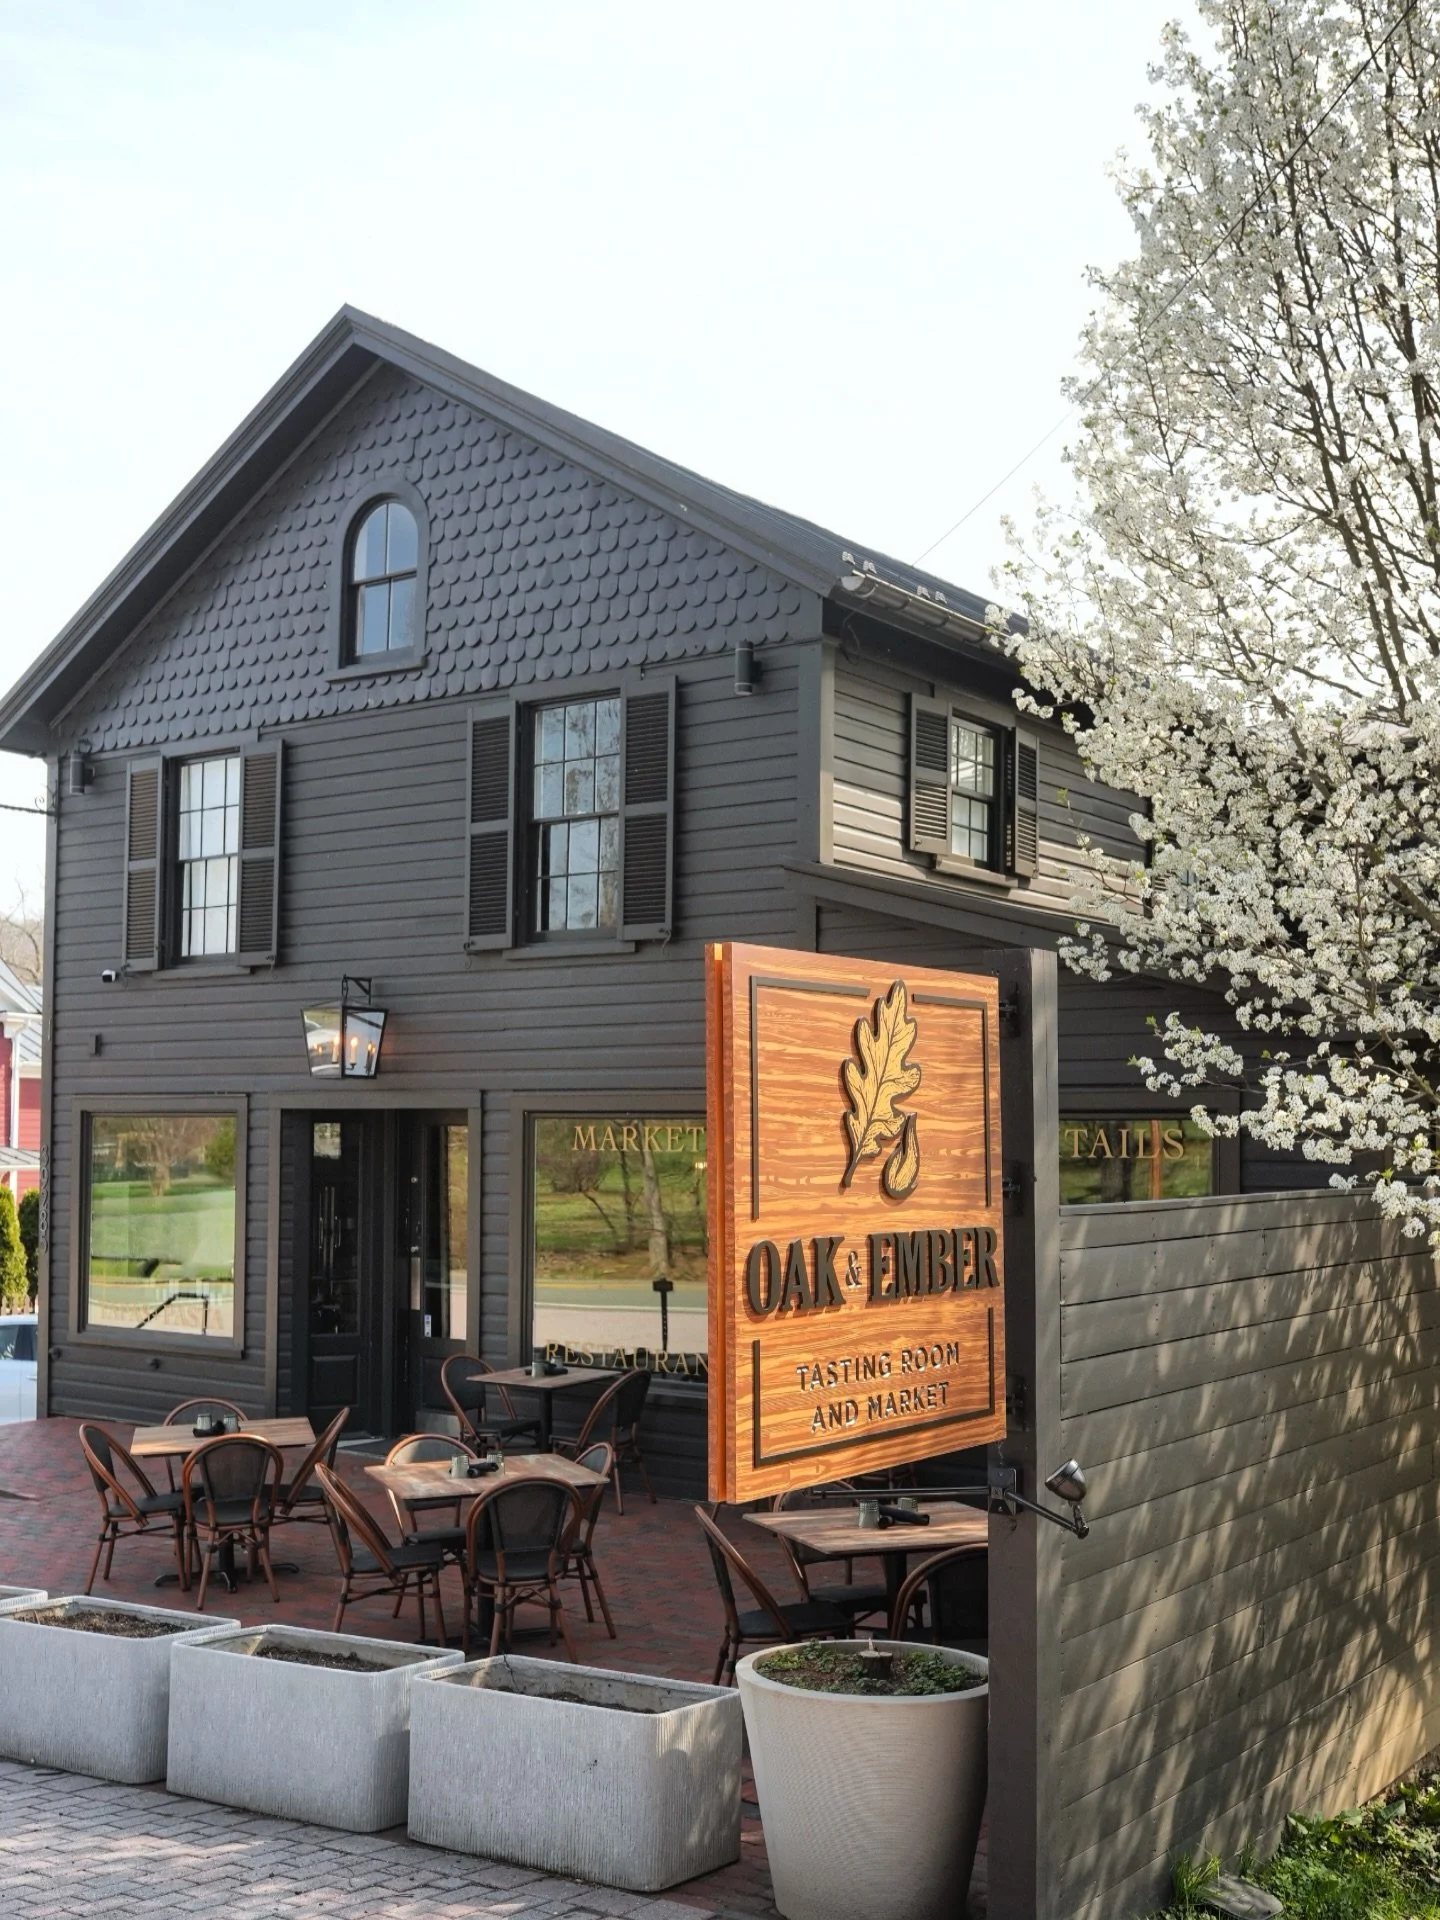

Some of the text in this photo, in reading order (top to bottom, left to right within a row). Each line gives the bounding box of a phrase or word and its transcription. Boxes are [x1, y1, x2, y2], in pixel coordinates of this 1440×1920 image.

[572, 1126, 707, 1153] MARKET
[1059, 1128, 1185, 1160] TAILS
[744, 1226, 1000, 1315] OAK & EMBER
[796, 1341, 960, 1392] TASTING ROOM
[811, 1381, 950, 1434] AND MARKET
